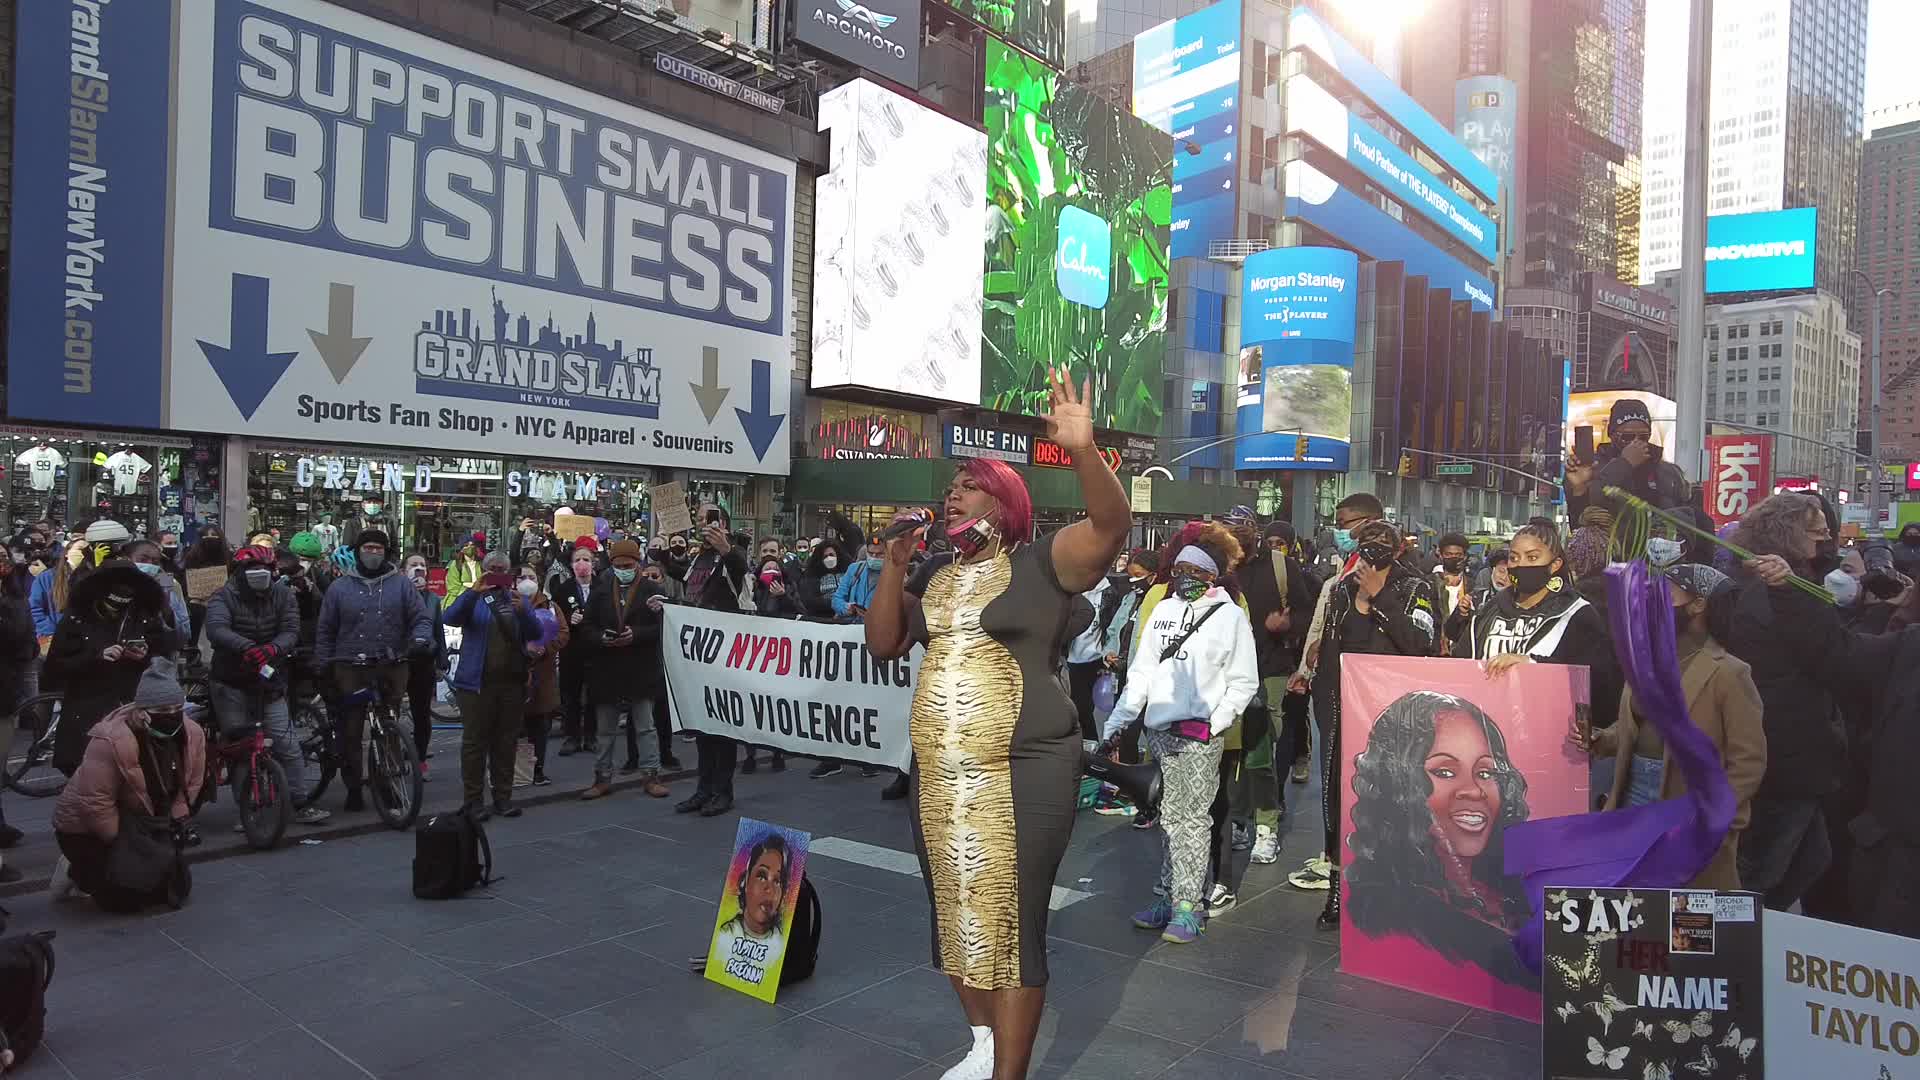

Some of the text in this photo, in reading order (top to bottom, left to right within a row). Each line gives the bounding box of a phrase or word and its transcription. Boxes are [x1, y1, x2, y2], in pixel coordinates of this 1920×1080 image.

[812, 8, 906, 59] ARCIMOTO
[661, 57, 779, 112] OUTFRONT PRIME
[238, 15, 774, 232] SUPPORT SMALL
[63, 0, 109, 394] randSlamNewYork.com
[233, 94, 774, 322] BUSINESS
[1354, 132, 1376, 163] Proud
[1376, 148, 1401, 180] Partner
[1400, 170, 1408, 184] of
[1408, 174, 1422, 198] THE
[1449, 203, 1484, 242] Championship
[1060, 235, 1107, 281] Calm
[1250, 272, 1345, 292] Morgan Stanley
[1264, 311, 1329, 321] THE PLAYERS
[415, 330, 661, 403] GRAND SLAM
[297, 394, 734, 455] Sports Fan Shop NYC Apparel Souvenirs
[520, 393, 571, 408] NEW YORK
[953, 425, 1027, 452] BLUE FIN
[1035, 442, 1059, 464] DOS
[36, 460, 51, 471] 99
[119, 464, 135, 475] 45
[296, 457, 598, 501] GRAND SLAM
[1716, 442, 1760, 516] tkts
[680, 624, 911, 688] END NYPD RIOTING
[704, 685, 882, 750] AND VIOLENCE
[1562, 898, 1633, 933] SAY
[732, 936, 769, 962] JUSTICE
[1617, 937, 1670, 972] HER
[1637, 974, 1729, 1011] NAME
[1785, 950, 1920, 1010] BREONN
[1805, 1000, 1920, 1057] TAYLO
